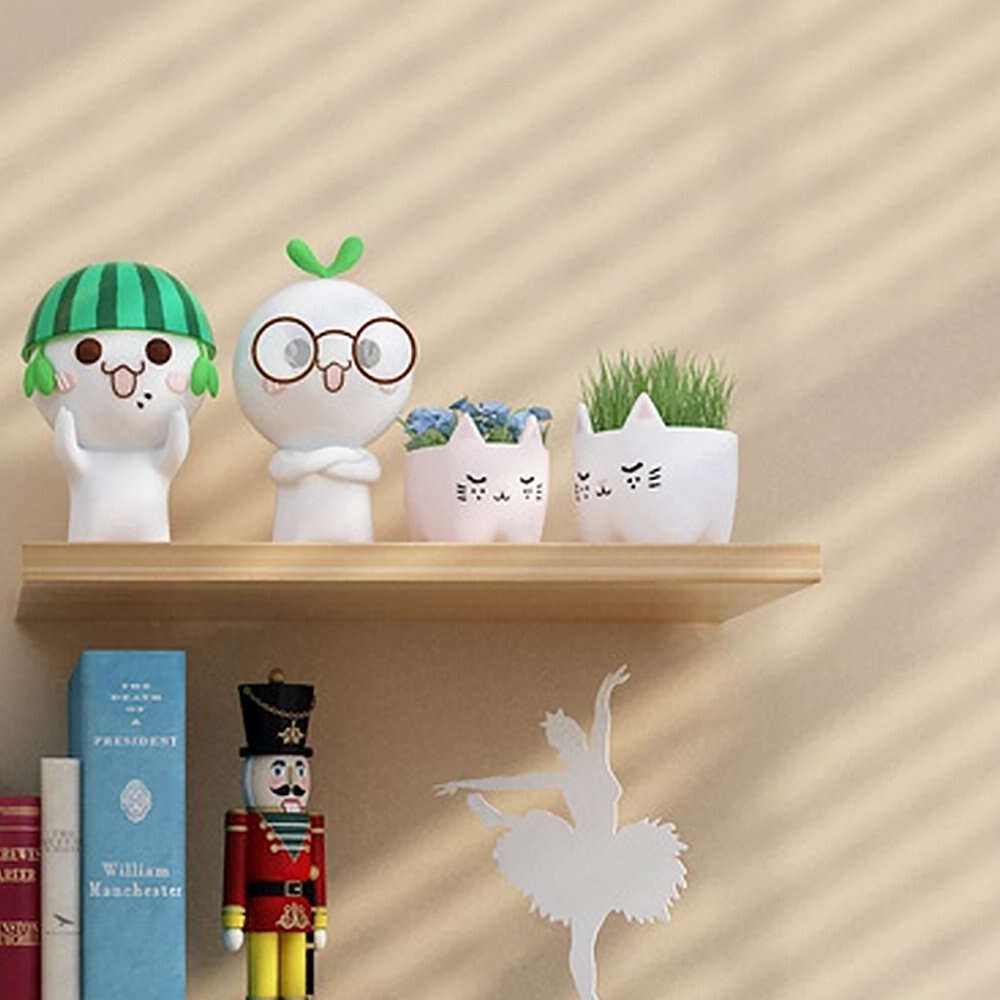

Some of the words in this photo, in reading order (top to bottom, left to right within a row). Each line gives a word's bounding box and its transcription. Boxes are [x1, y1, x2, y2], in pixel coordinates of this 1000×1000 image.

[94, 736, 177, 747] PRESIDENT
[102, 861, 170, 878] William
[88, 880, 182, 898] Manchester
